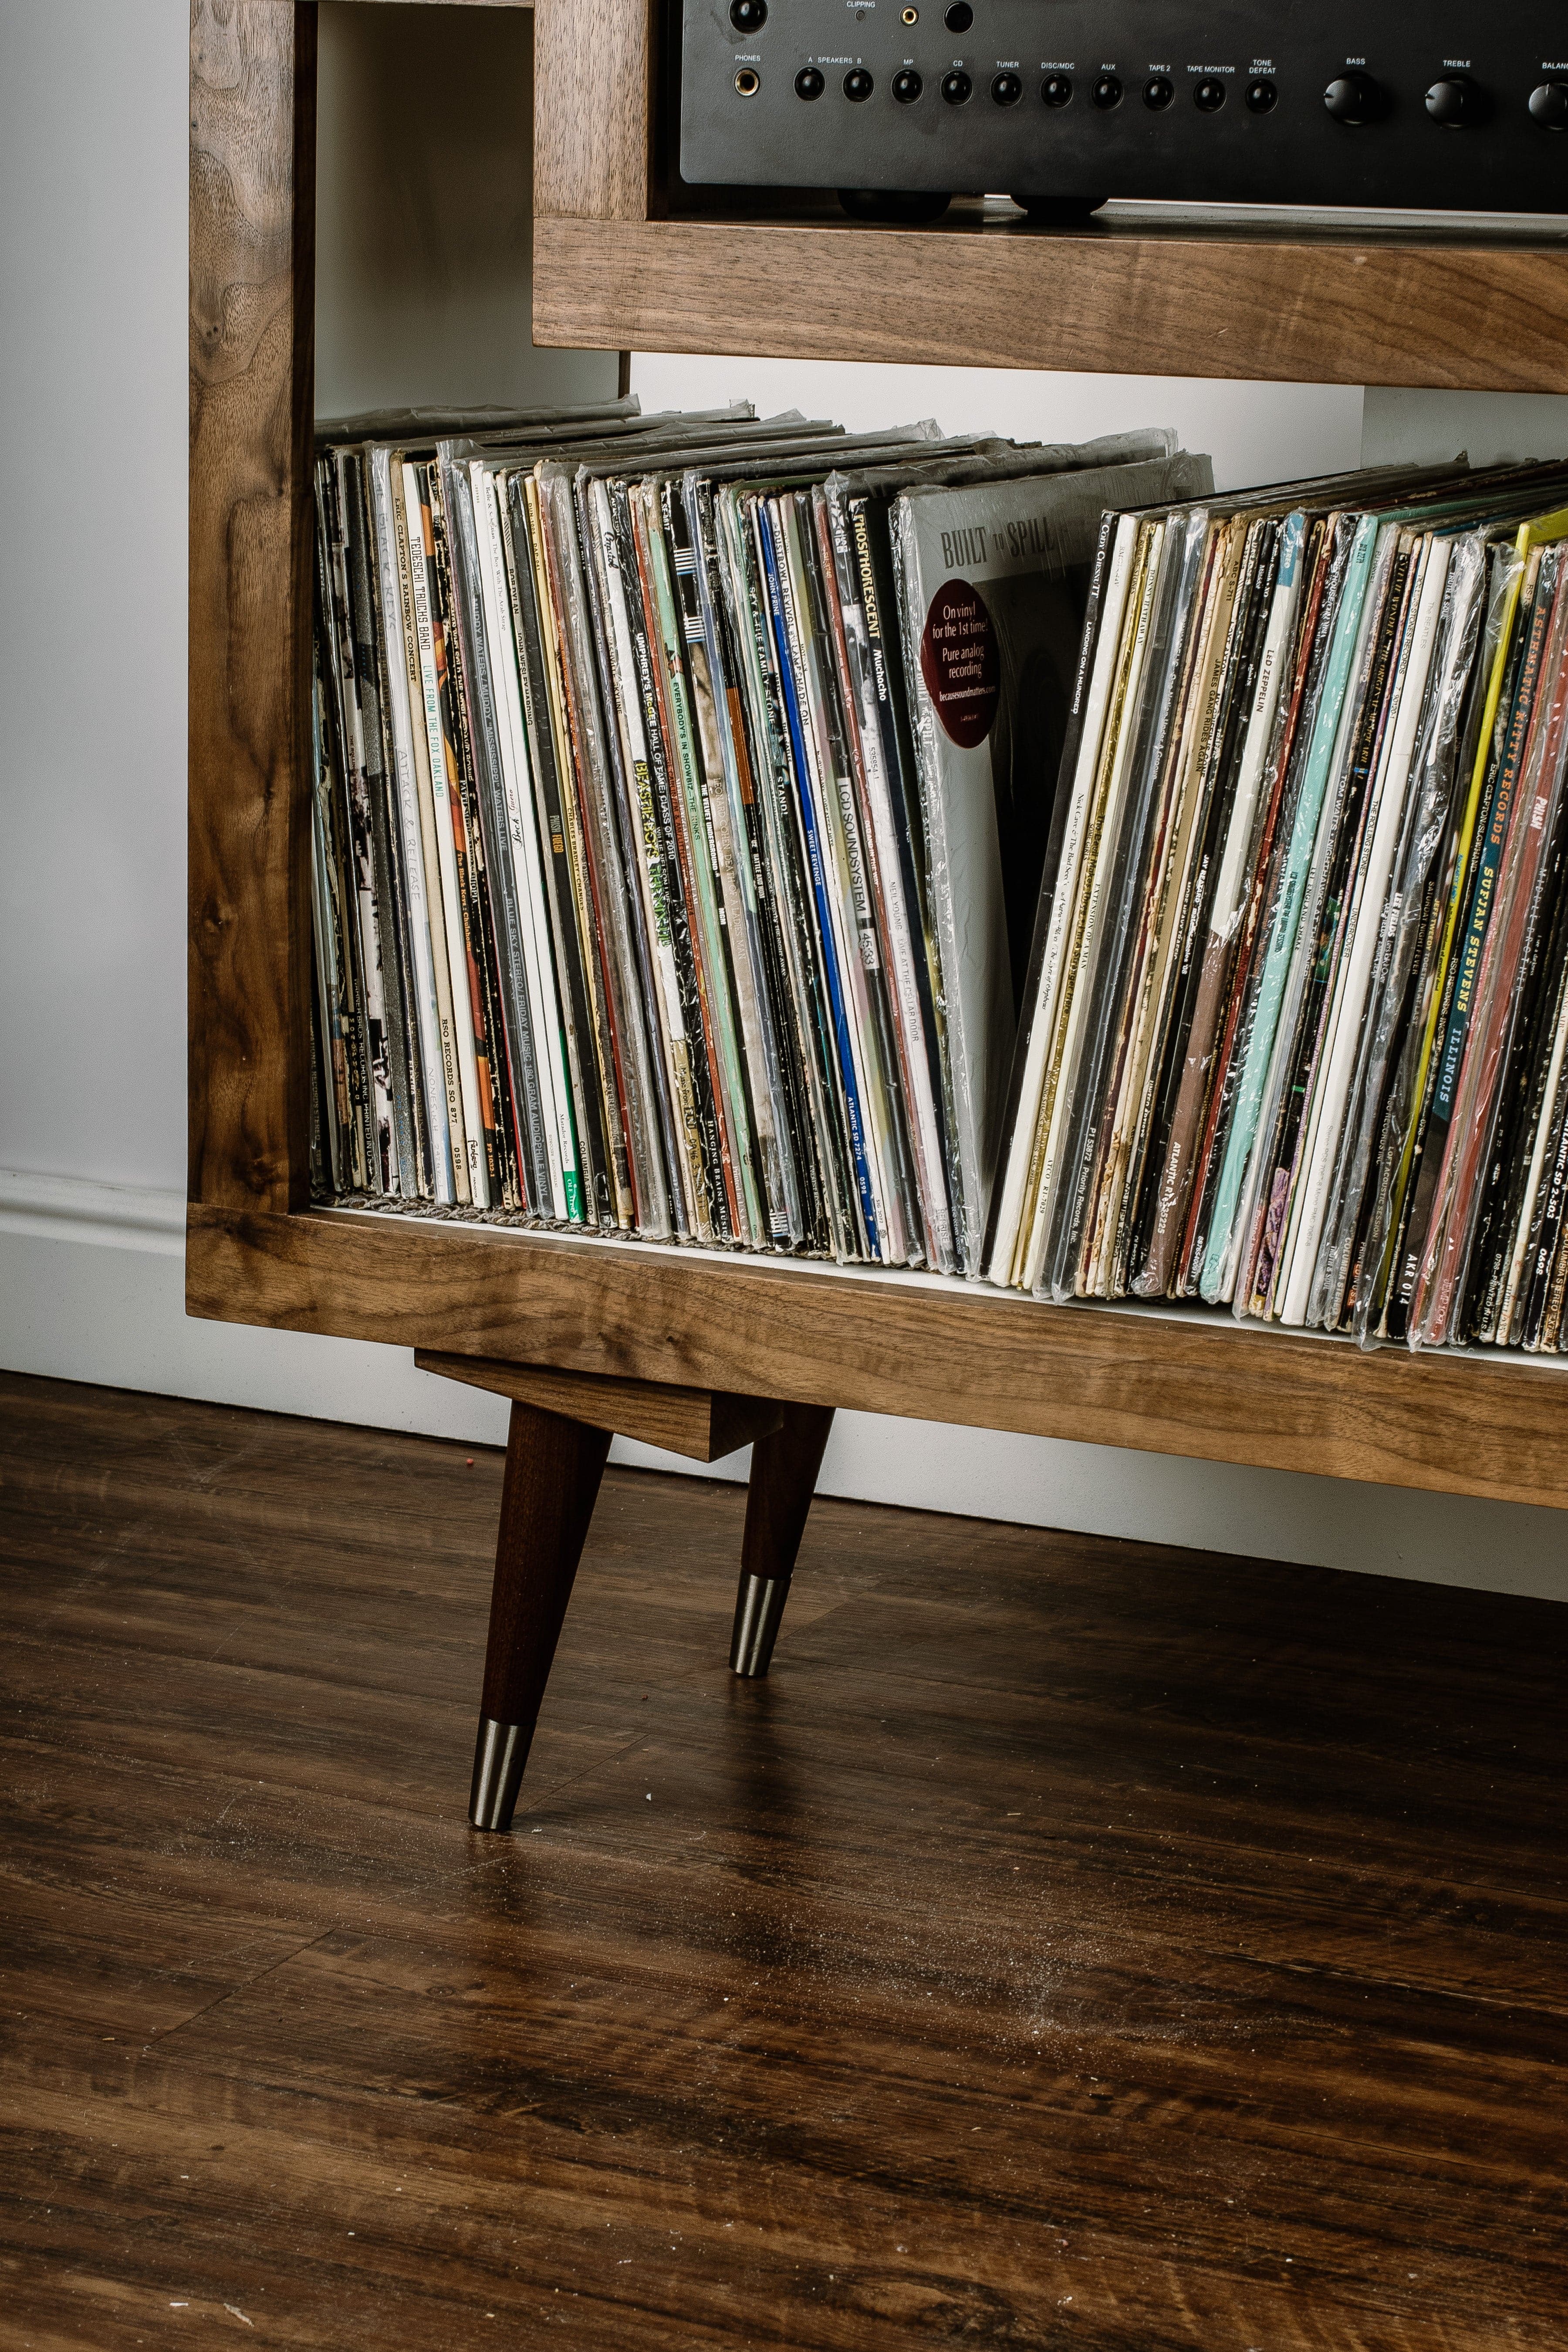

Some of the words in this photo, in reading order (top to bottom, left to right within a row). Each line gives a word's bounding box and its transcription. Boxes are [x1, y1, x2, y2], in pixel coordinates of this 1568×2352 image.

[397, 524, 408, 579] CLAPTON'S
[941, 526, 988, 570] BUILT
[1007, 516, 1054, 558] SPILL
[410, 536, 424, 583] TEDESCHI
[1230, 560, 1239, 578] ABC
[767, 572, 777, 593] JOHN
[853, 513, 880, 639] PHOSPHORESCENT
[415, 586, 428, 622] TRUCKS
[1225, 579, 1235, 602] S-711
[402, 583, 412, 631] RAINBOW
[771, 595, 780, 616] PRINE
[943, 605, 956, 620] On
[956, 601, 976, 619] vinyl
[419, 626, 430, 650] BAND
[933, 623, 945, 640] for
[945, 622, 957, 638] the
[958, 621, 969, 636] 1st
[970, 618, 988, 635] time!
[1419, 616, 1431, 649] BEATLES
[407, 635, 416, 682] CONCERT
[635, 632, 652, 691] UMPHREY'S
[943, 646, 960, 662] Pure
[960, 642, 985, 661] analog
[1264, 649, 1274, 666] LED
[1398, 638, 1411, 675] RECORDS
[1518, 606, 1547, 705] ASTHMATIC
[423, 665, 433, 684] LIVE
[872, 648, 888, 701] Muchacho
[949, 662, 983, 679] recording
[1210, 658, 1222, 688] JAMES
[426, 688, 436, 712] FROM
[939, 685, 997, 702] becausesoundmatters.com
[1205, 689, 1216, 715] GANG
[1256, 669, 1271, 713] ZEPPELIN
[645, 692, 656, 727] McGEE
[428, 717, 438, 732] THE
[1200, 717, 1211, 743] RIDES
[1507, 710, 1526, 763] KITTY
[430, 737, 439, 753] FOX
[650, 728, 660, 751] HALL
[653, 752, 662, 765] OF
[1195, 745, 1206, 773] AGAIN
[433, 758, 444, 797] OAKLAND
[460, 779, 469, 804] PATTI
[700, 783, 708, 797] THE
[659, 794, 670, 824] CLASS
[702, 798, 712, 821] VELVET
[713, 777, 726, 818] LEONARD
[775, 776, 788, 816] STAND!
[838, 783, 852, 811] LCD
[1075, 793, 1085, 810] Nick
[1370, 800, 1379, 815] THE
[1490, 767, 1514, 845] RECORDS
[548, 814, 561, 834] PHISH
[1072, 811, 1081, 828] Cave
[1529, 795, 1548, 830] PHISH
[508, 814, 523, 851] Beck
[550, 833, 566, 854] FUEGO
[664, 825, 672, 838] OF
[719, 819, 730, 850] COHEN
[751, 839, 757, 848] U2
[807, 829, 816, 852] SWEET
[1068, 837, 1077, 851] The
[1364, 815, 1376, 847] ROLLING
[567, 808, 575, 839] CHARLES
[571, 841, 580, 872] BRADLEY
[576, 878, 585, 911] CHANGES
[666, 840, 676, 860] 2010
[705, 821, 719, 871] UNDERGROUND
[1066, 852, 1075, 866] Bad
[724, 854, 735, 884] DEATH
[753, 853, 761, 873] RATTLE
[811, 853, 821, 886] REVENGE
[842, 812, 866, 912] SOUNDSYSTEM
[1358, 847, 1369, 877] STONES
[728, 884, 737, 897] OF
[888, 881, 898, 900] NEIL
[1392, 892, 1404, 909] LEE
[1421, 881, 1435, 922] SATURDAY
[1473, 866, 1495, 931] SUFJAN
[506, 898, 516, 925] BLUE
[731, 907, 743, 936] LADIES
[891, 901, 902, 931] YOUNG
[1431, 898, 1441, 918] JEFF
[463, 912, 472, 952] Chulahoma
[1342, 907, 1358, 958] UNDERCOVER
[1387, 908, 1400, 938] FIELDS
[1416, 923, 1427, 948] NIGHT
[1425, 919, 1436, 951] TWEEDY
[510, 927, 518, 948] SKY
[736, 939, 746, 960] MAN
[860, 932, 875, 965] 45:33
[1412, 949, 1422, 975] FEVER
[1417, 952, 1430, 993] TOGETHER
[1456, 935, 1480, 1012] STEVENS
[517, 994, 528, 1028] FRIDAY
[1415, 993, 1423, 1004] AT
[1411, 1005, 1420, 1025] LAST
[522, 1031, 532, 1062] MUSIC
[444, 1041, 453, 1085] RECORDS
[526, 1064, 534, 1079] 180
[1439, 1027, 1462, 1102] ILLINOIS
[448, 1089, 455, 1102] SO
[527, 1081, 537, 1110] GRAM
[847, 1096, 858, 1130] ATLANTIC
[531, 1112, 544, 1169] AUDIOPHILE
[852, 1132, 859, 1141] SD
[706, 1120, 720, 1165] HANGING
[713, 1168, 724, 1202] BRAINS
[1044, 1157, 1053, 1179] ATCO
[1165, 1141, 1182, 1185] ATLANTIC
[538, 1171, 547, 1197] VINYL
[579, 1140, 589, 1183] COLUMBIA
[584, 1184, 593, 1216] STEREO
[732, 1165, 741, 1191] Printed
[1077, 1166, 1089, 1194] Priority
[1553, 1171, 1563, 1186] SD
[1039, 1186, 1049, 1214] R1-7029
[1071, 1195, 1085, 1229] Records,
[1546, 1187, 1560, 1220] 2-503
[1069, 1230, 1078, 1244] Inc.
[1404, 1254, 1419, 1278] AKR
[1534, 1247, 1548, 1276] 0698
[1398, 1282, 1413, 1305] 014
